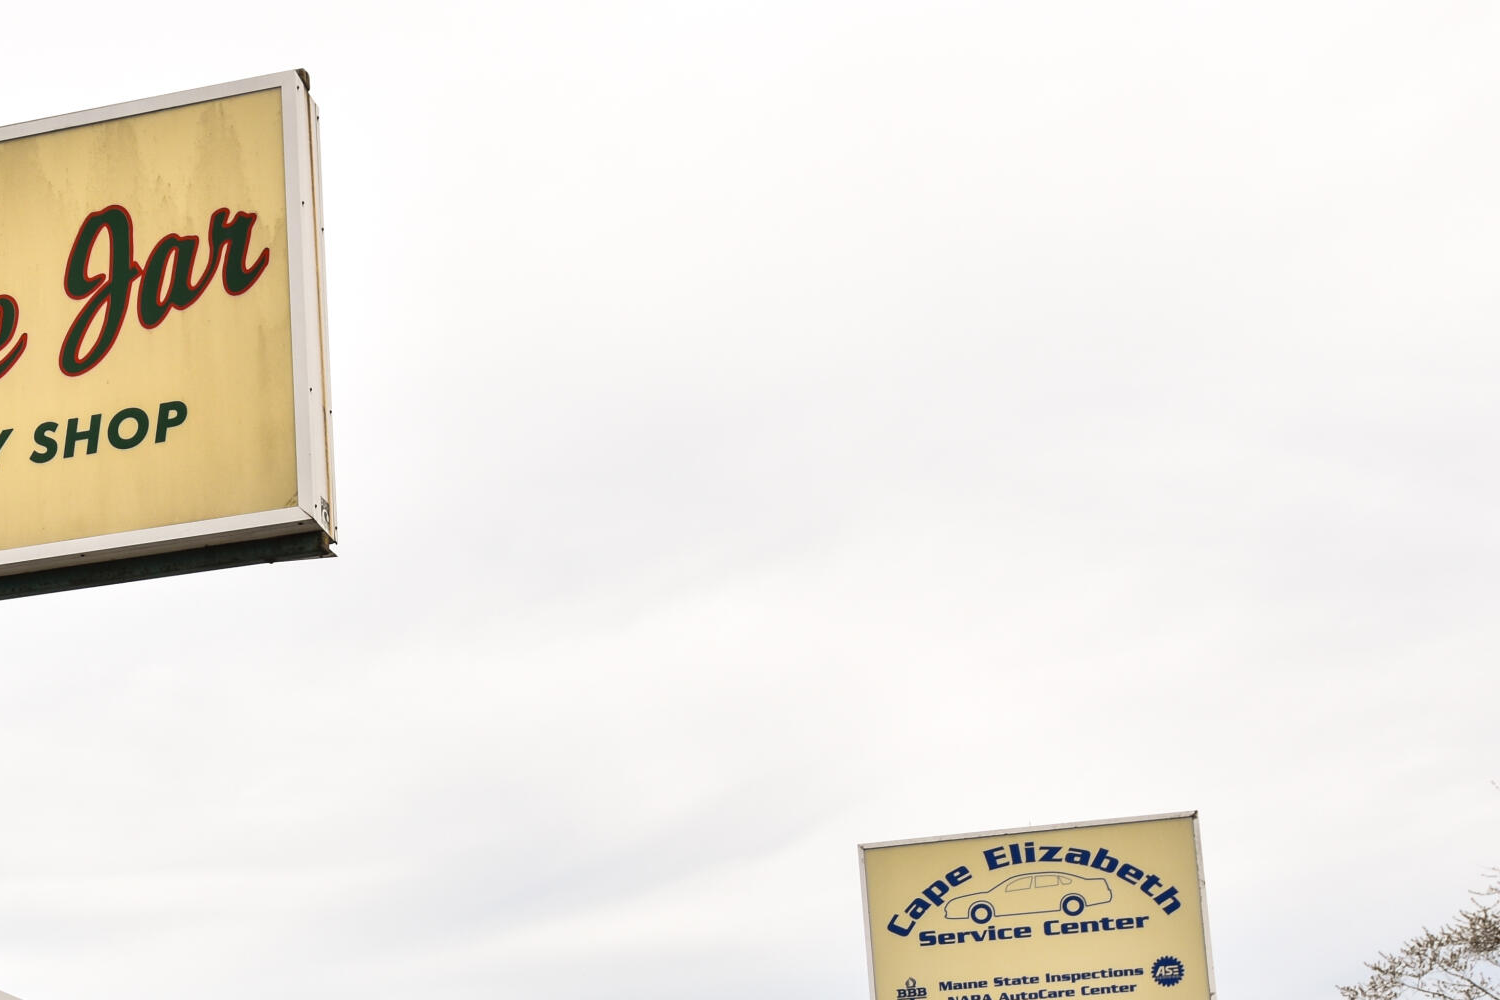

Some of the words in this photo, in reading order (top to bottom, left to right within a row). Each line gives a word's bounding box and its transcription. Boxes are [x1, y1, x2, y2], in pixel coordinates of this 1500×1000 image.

[58, 205, 270, 377] Jar
[28, 401, 188, 464] SHOP
[887, 865, 973, 937] Cape
[983, 841, 1182, 916] Elizabeth
[918, 925, 1032, 947] Service
[1043, 915, 1150, 936] Center
[939, 980, 988, 991] Maine
[993, 976, 1039, 987] State
[1045, 967, 1144, 983] Inspections
[1156, 965, 1179, 977] ASE
[896, 987, 928, 998] BBB
[1080, 984, 1137, 996] Center
